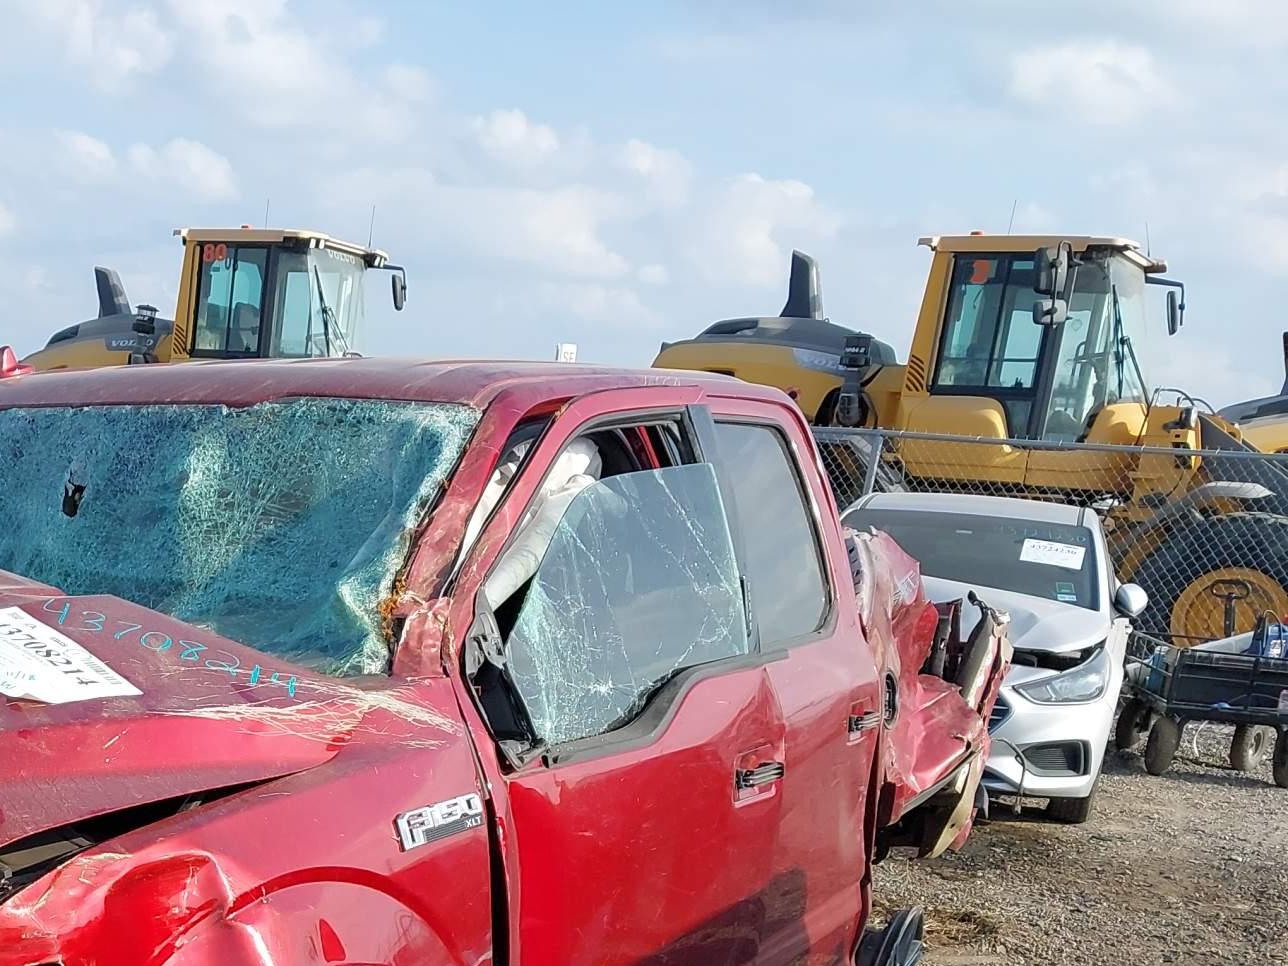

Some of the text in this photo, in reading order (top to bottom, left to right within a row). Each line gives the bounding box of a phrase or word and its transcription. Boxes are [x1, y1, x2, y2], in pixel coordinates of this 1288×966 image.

[112, 338, 154, 348] VOLO
[42, 598, 297, 698] 43708214
[464, 816, 482, 828] XLT
